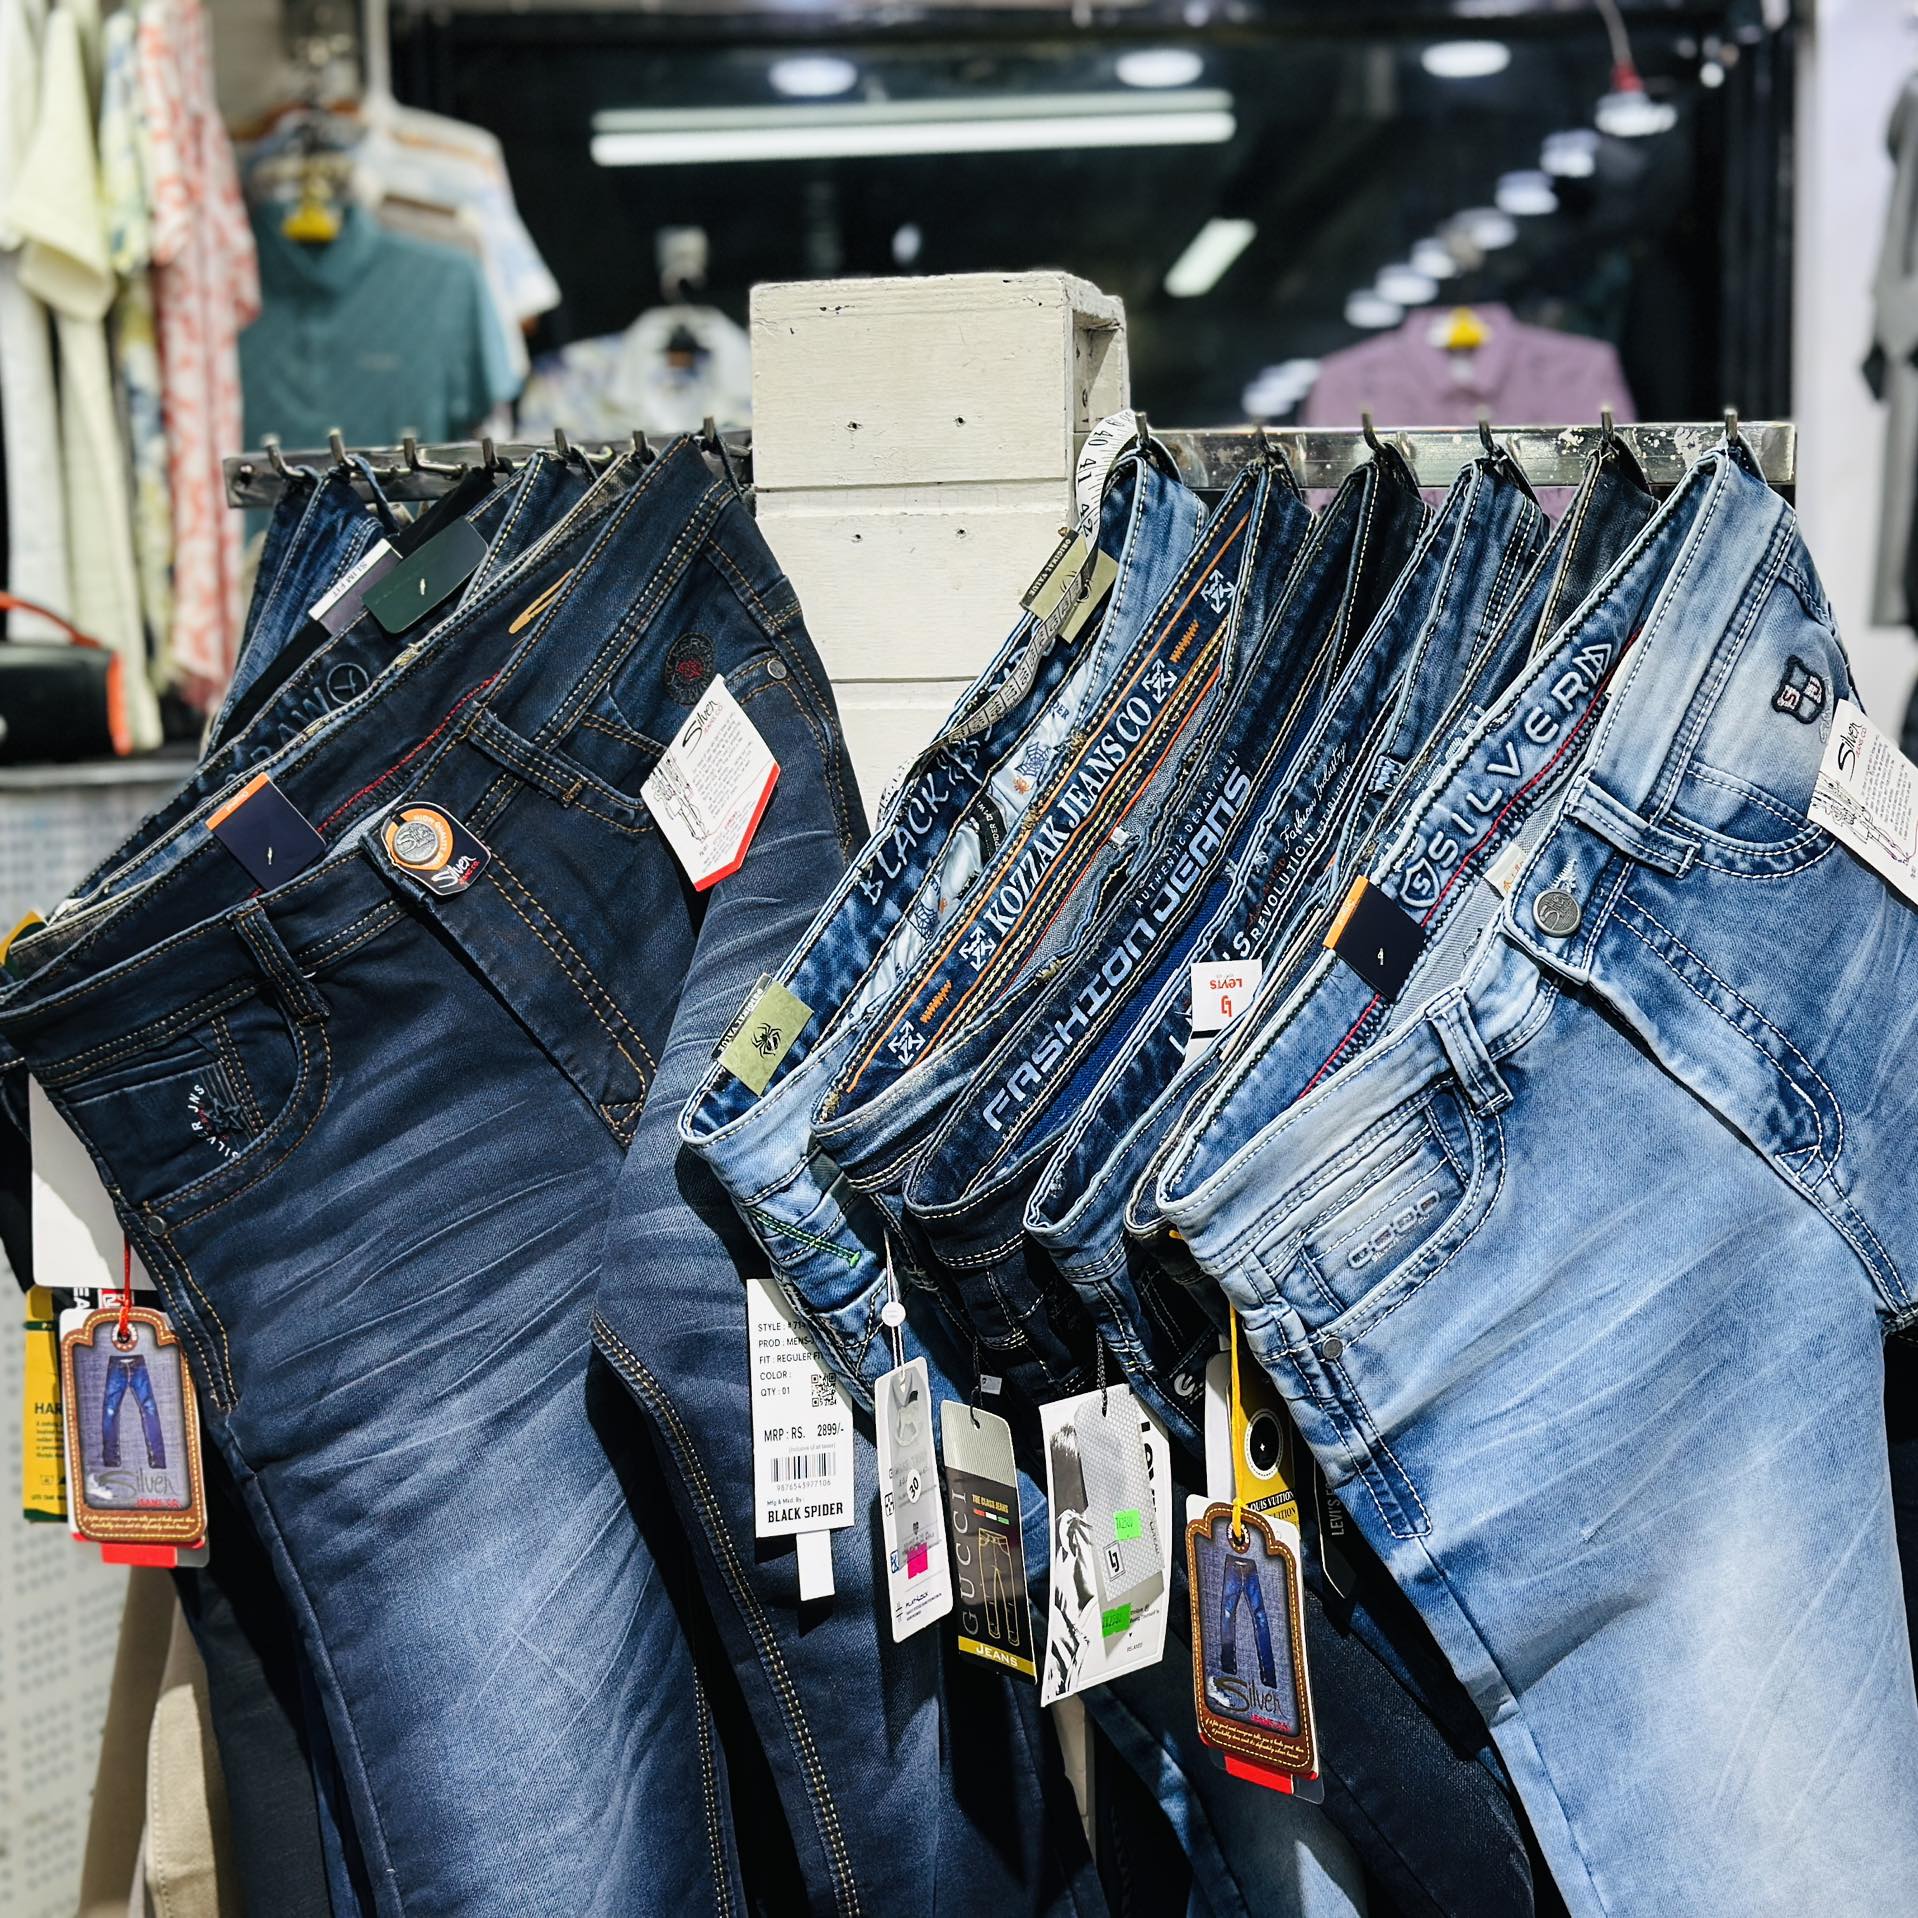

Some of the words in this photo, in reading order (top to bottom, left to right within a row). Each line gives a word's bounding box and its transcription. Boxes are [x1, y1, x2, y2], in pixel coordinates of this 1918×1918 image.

[985, 822, 1073, 936] KOZZAK
[1058, 735, 1129, 840] JEANS
[982, 916, 1157, 1133] FASHION
[1151, 766, 1251, 923] JEANS
[758, 1322, 781, 1332] STYLE
[758, 1338, 781, 1348] PROD
[759, 1355, 771, 1365] FIT
[776, 1352, 812, 1363] REGULER
[760, 1370, 788, 1381] COLOR
[760, 1388, 779, 1397] QTY
[782, 1386, 790, 1395] 01
[764, 1427, 785, 1442] MRP
[816, 1422, 845, 1437] 2899/-
[768, 1507, 801, 1523] BLACK
[804, 1502, 844, 1519] SPIDER
[951, 1489, 978, 1635] GUCCI
[976, 1641, 1019, 1668] JEANS
